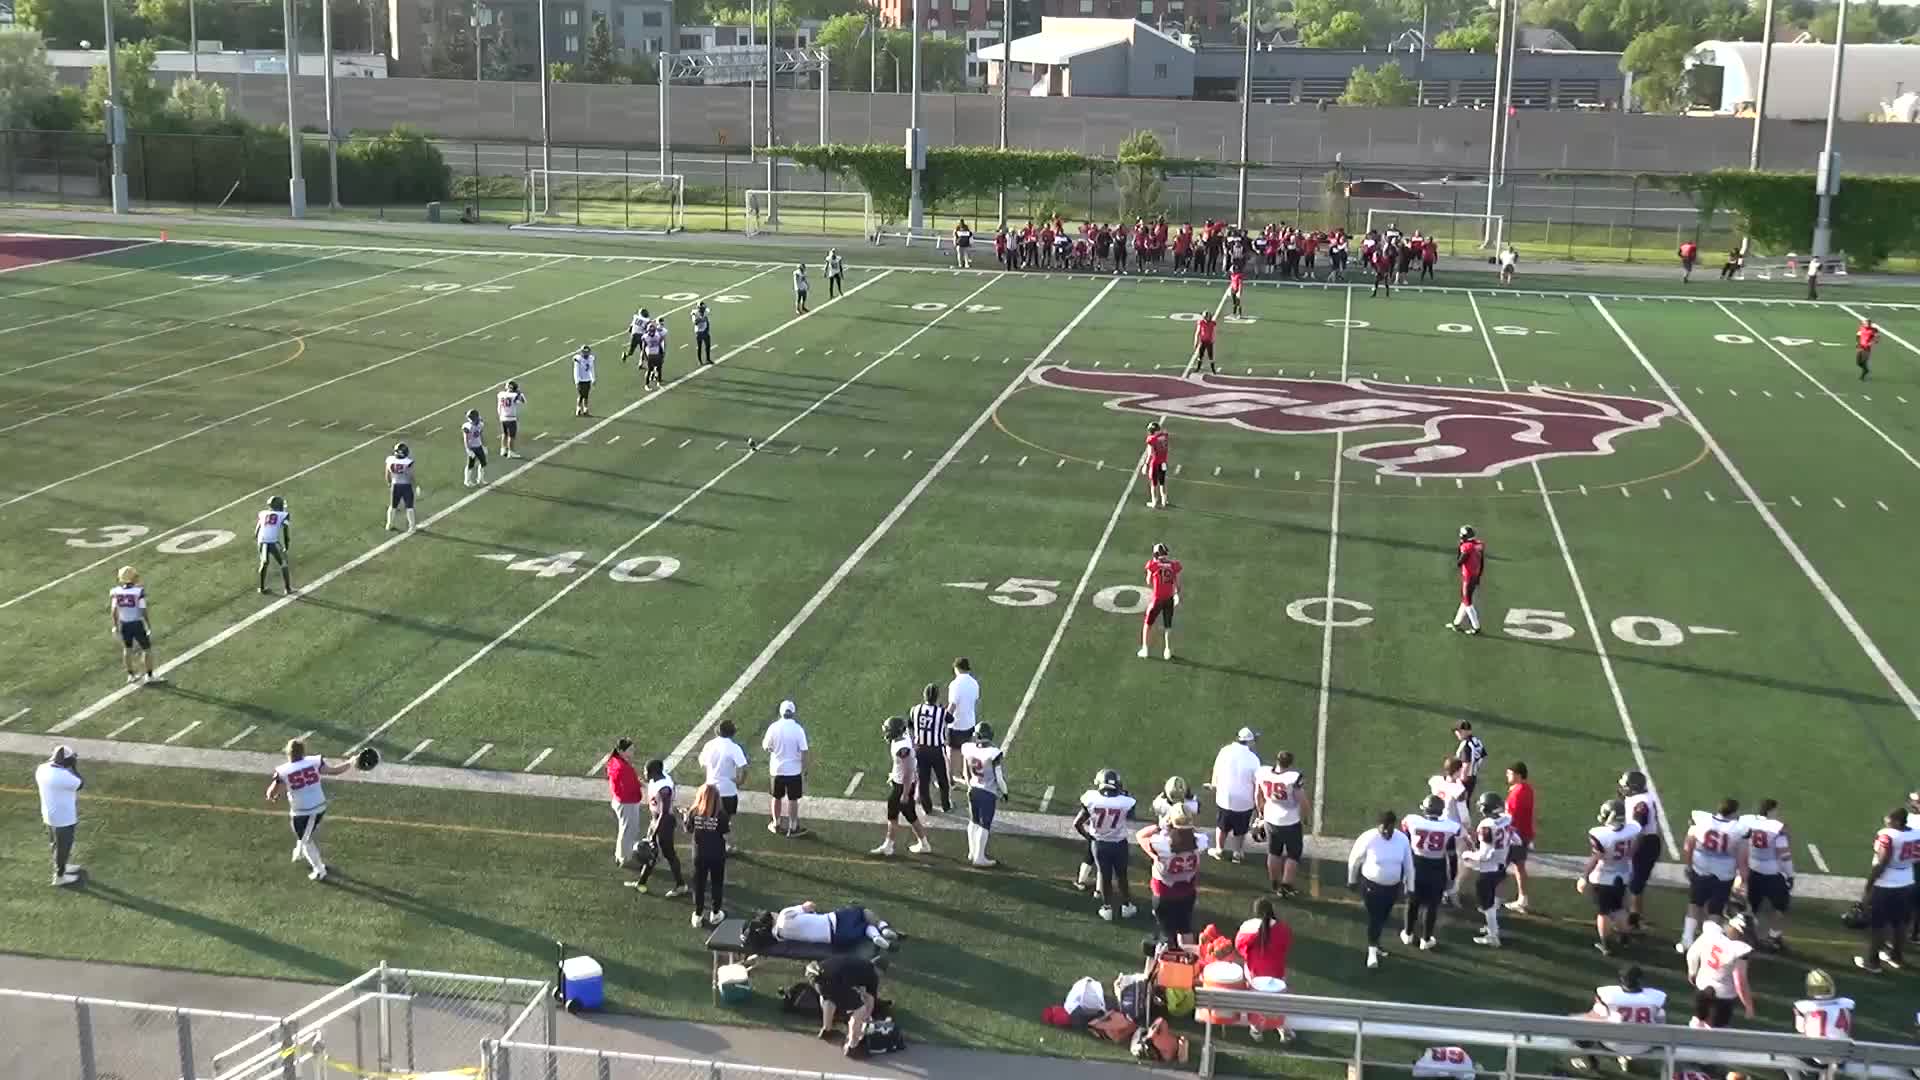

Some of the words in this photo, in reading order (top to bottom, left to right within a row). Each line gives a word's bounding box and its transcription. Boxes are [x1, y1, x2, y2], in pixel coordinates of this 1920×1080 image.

[66, 524, 237, 554] 30
[506, 552, 681, 582] 40
[988, 577, 1152, 614] 50
[1286, 597, 1374, 627] C
[1503, 608, 1684, 647] 50
[919, 716, 934, 729] 97
[287, 766, 320, 790] 55
[1094, 807, 1121, 829] 77
[1415, 829, 1446, 852] 79
[1703, 830, 1729, 852] 61
[1617, 1006, 1651, 1024] 78
[1810, 1008, 1849, 1036] 74
